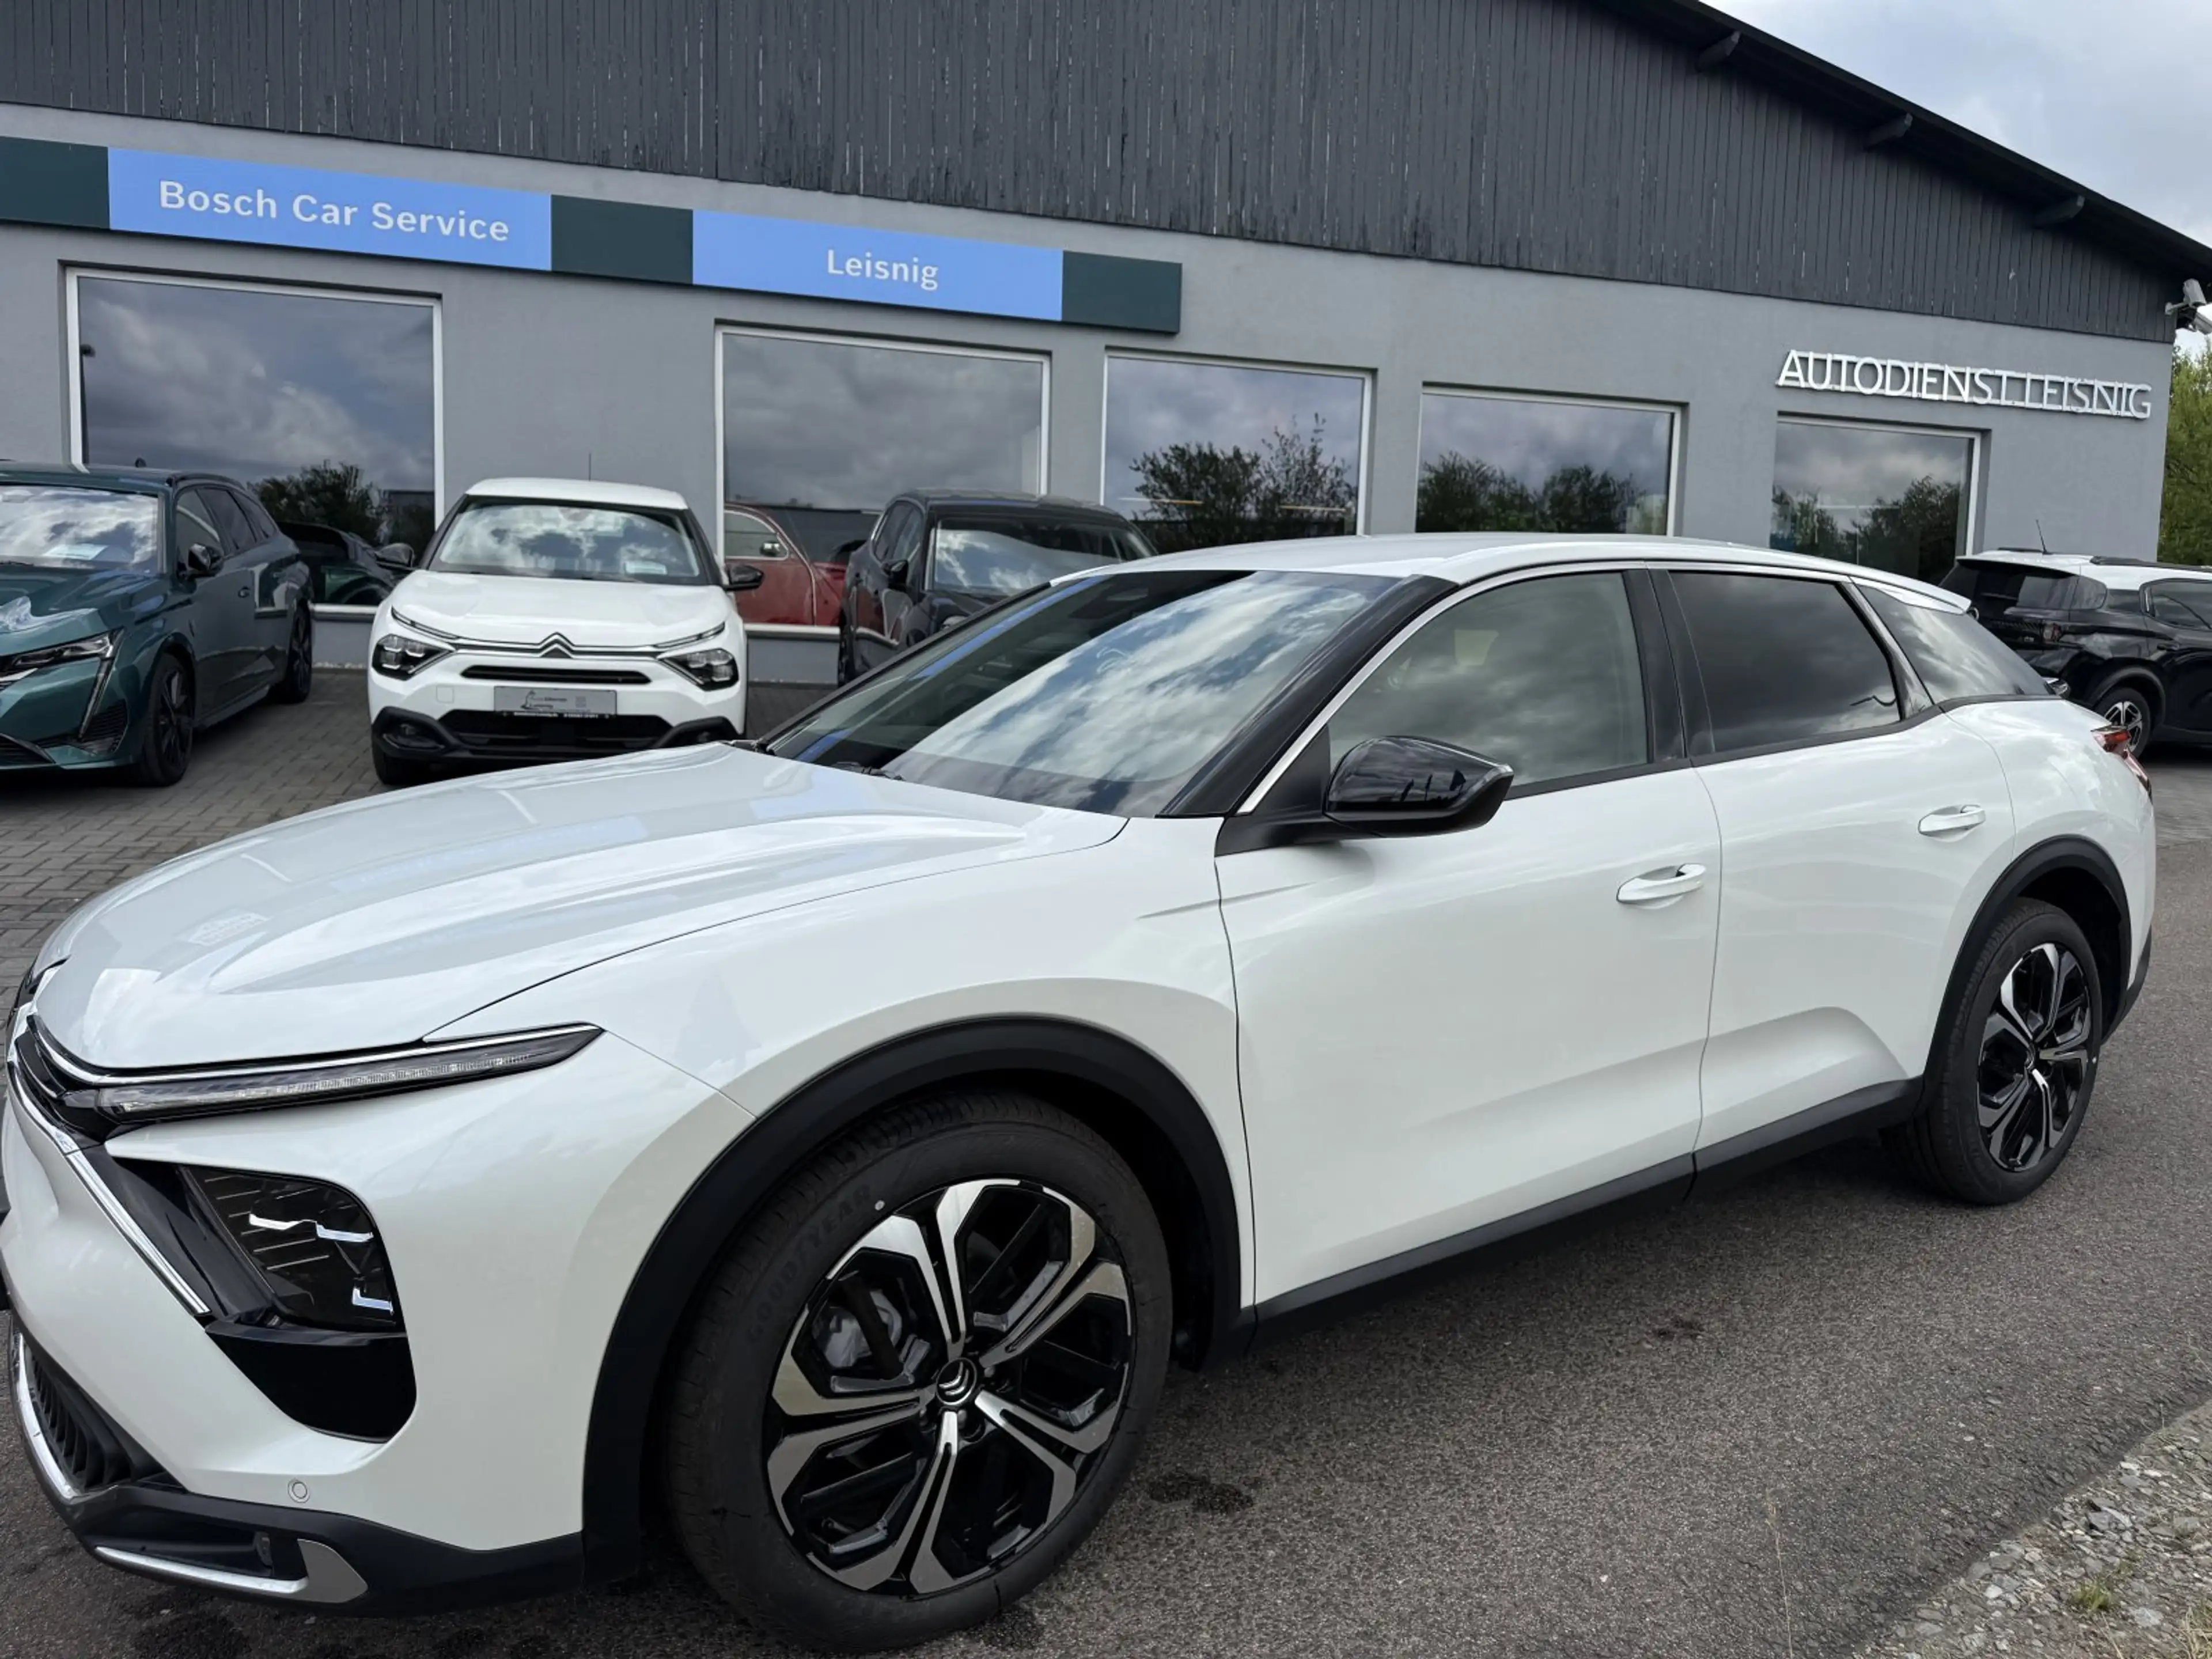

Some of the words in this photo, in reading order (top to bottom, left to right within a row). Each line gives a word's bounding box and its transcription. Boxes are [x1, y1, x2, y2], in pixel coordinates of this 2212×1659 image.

[160, 180, 277, 218] Bosch
[292, 194, 358, 226] Car
[372, 202, 509, 241] Service
[827, 249, 938, 290] Leisnig
